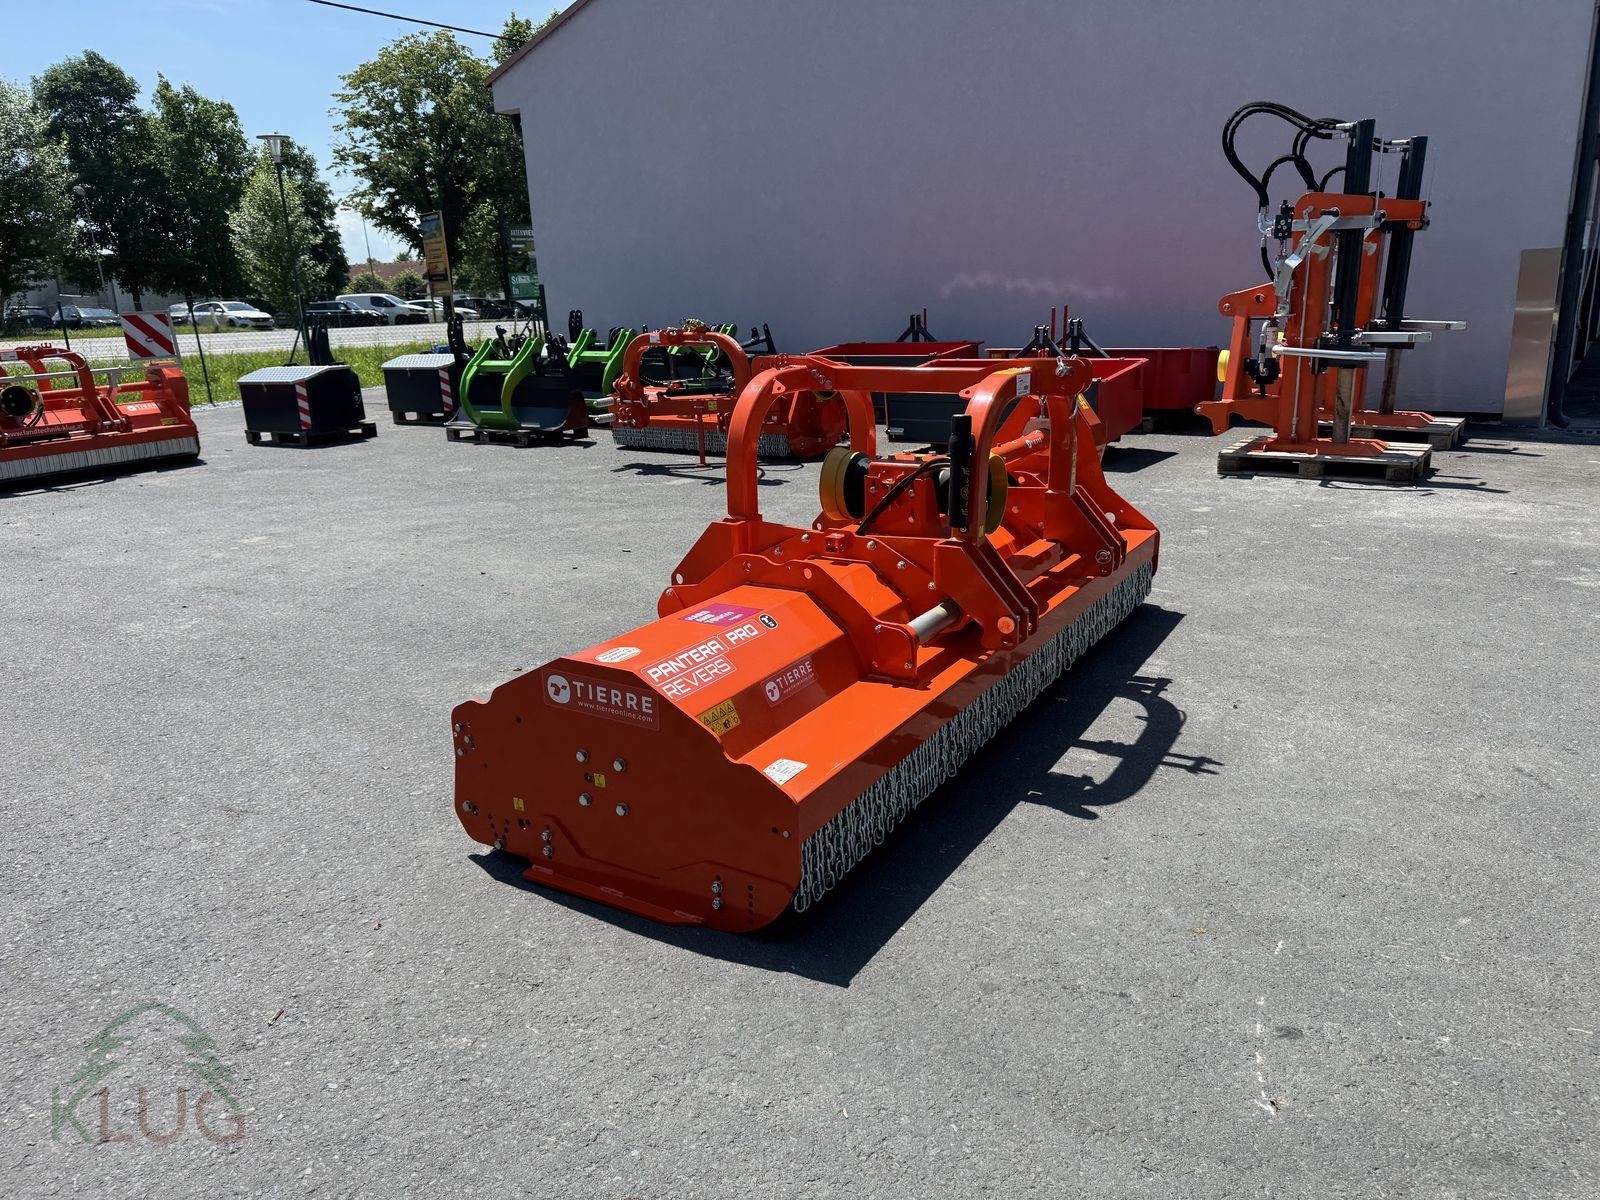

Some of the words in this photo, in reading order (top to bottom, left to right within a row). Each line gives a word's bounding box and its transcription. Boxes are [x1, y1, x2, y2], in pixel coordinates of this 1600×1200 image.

[647, 640, 724, 682] PANTERA
[725, 623, 759, 645] PRO
[661, 659, 731, 700] REVERS
[776, 661, 813, 689] TIERRE
[572, 680, 653, 714] TIERRE
[577, 700, 653, 723] www.tierreonline.com
